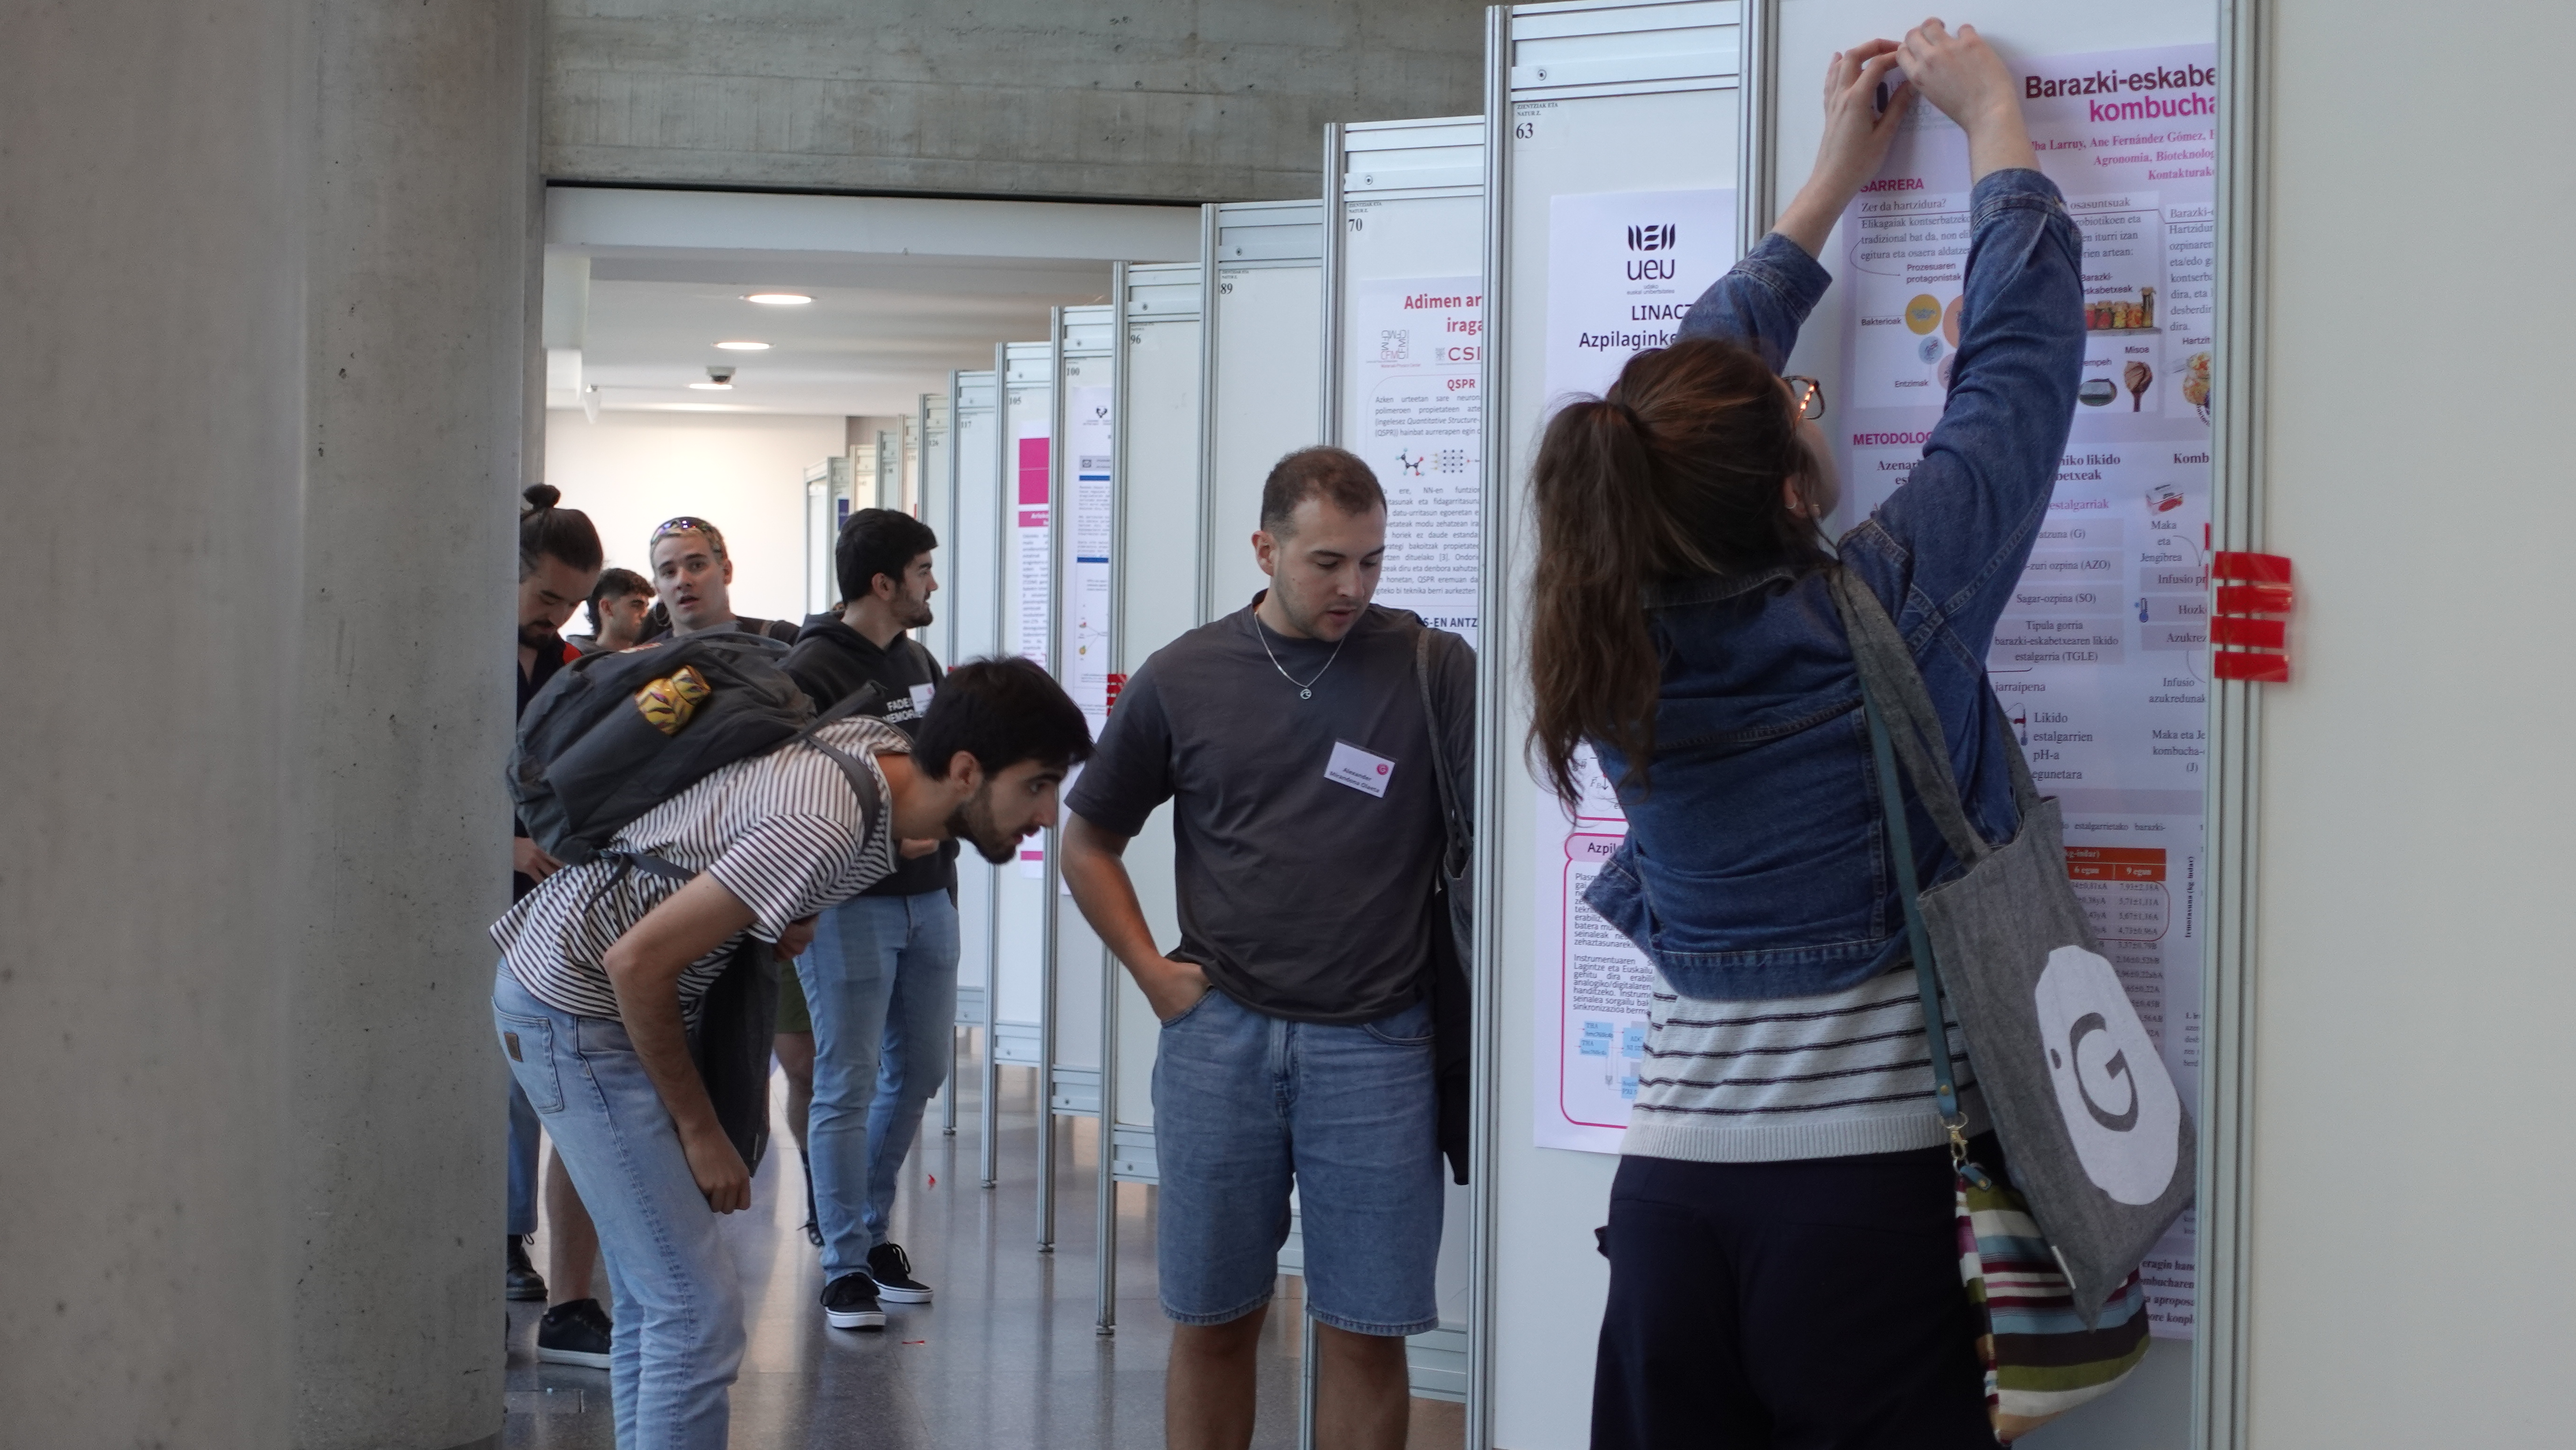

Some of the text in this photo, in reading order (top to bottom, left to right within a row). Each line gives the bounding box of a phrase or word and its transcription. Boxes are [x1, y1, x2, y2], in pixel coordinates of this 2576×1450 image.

[1516, 122, 1533, 139] 63
[2090, 137, 2109, 147] Ane
[2112, 134, 2164, 146] Fernández
[2094, 155, 2152, 167] Agronomia,
[2148, 167, 2215, 180] Kontakturak
[1861, 199, 1947, 212] Zer da hartzidura?
[1348, 218, 1362, 232] 70
[1861, 218, 1906, 229] Elikagaiak
[2076, 217, 2125, 226] robiotikoen
[1861, 233, 1907, 244] tradizional
[1909, 233, 1923, 242] bat
[1861, 250, 1890, 261] egitura
[1907, 263, 1956, 271] Prozesuaren
[1907, 274, 1962, 284] protagonistak
[1221, 283, 1232, 294] 89
[2083, 285, 2133, 295] skabetxeak
[1404, 293, 1461, 309] Adimen
[1130, 334, 1141, 345] 96
[1448, 379, 1475, 391] QSPR
[2087, 454, 2120, 465] likido
[1877, 460, 1919, 471] Azenar
[2150, 521, 2177, 529] Maka
[2163, 678, 2195, 687] Infusio
[2034, 712, 2068, 724] Likido
[2033, 751, 2059, 762] pH-a
[2032, 770, 2082, 780] egunetara
